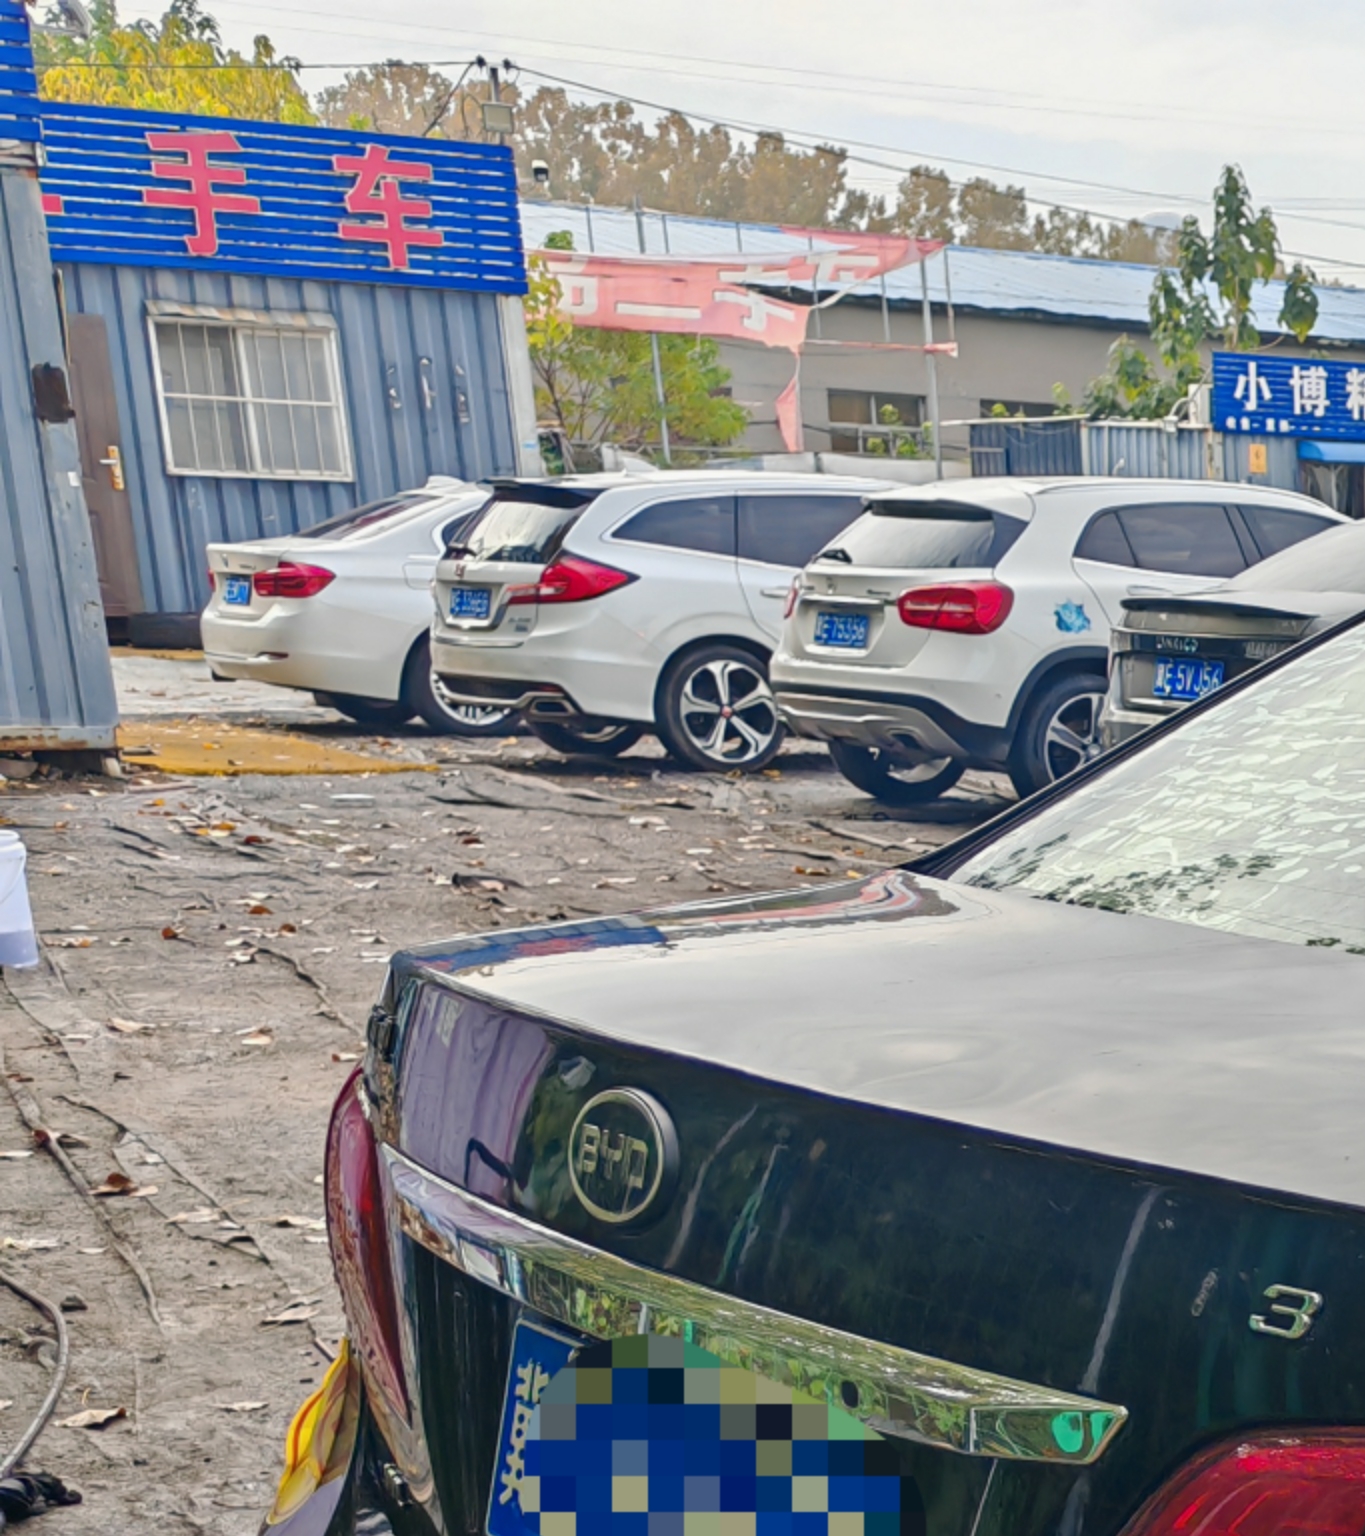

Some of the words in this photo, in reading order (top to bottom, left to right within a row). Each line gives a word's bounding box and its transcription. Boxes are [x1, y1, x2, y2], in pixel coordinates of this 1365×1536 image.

[42, 131, 445, 270] 手车
[577, 1122, 649, 1189] BYD
[1248, 1283, 1323, 1339] 3
